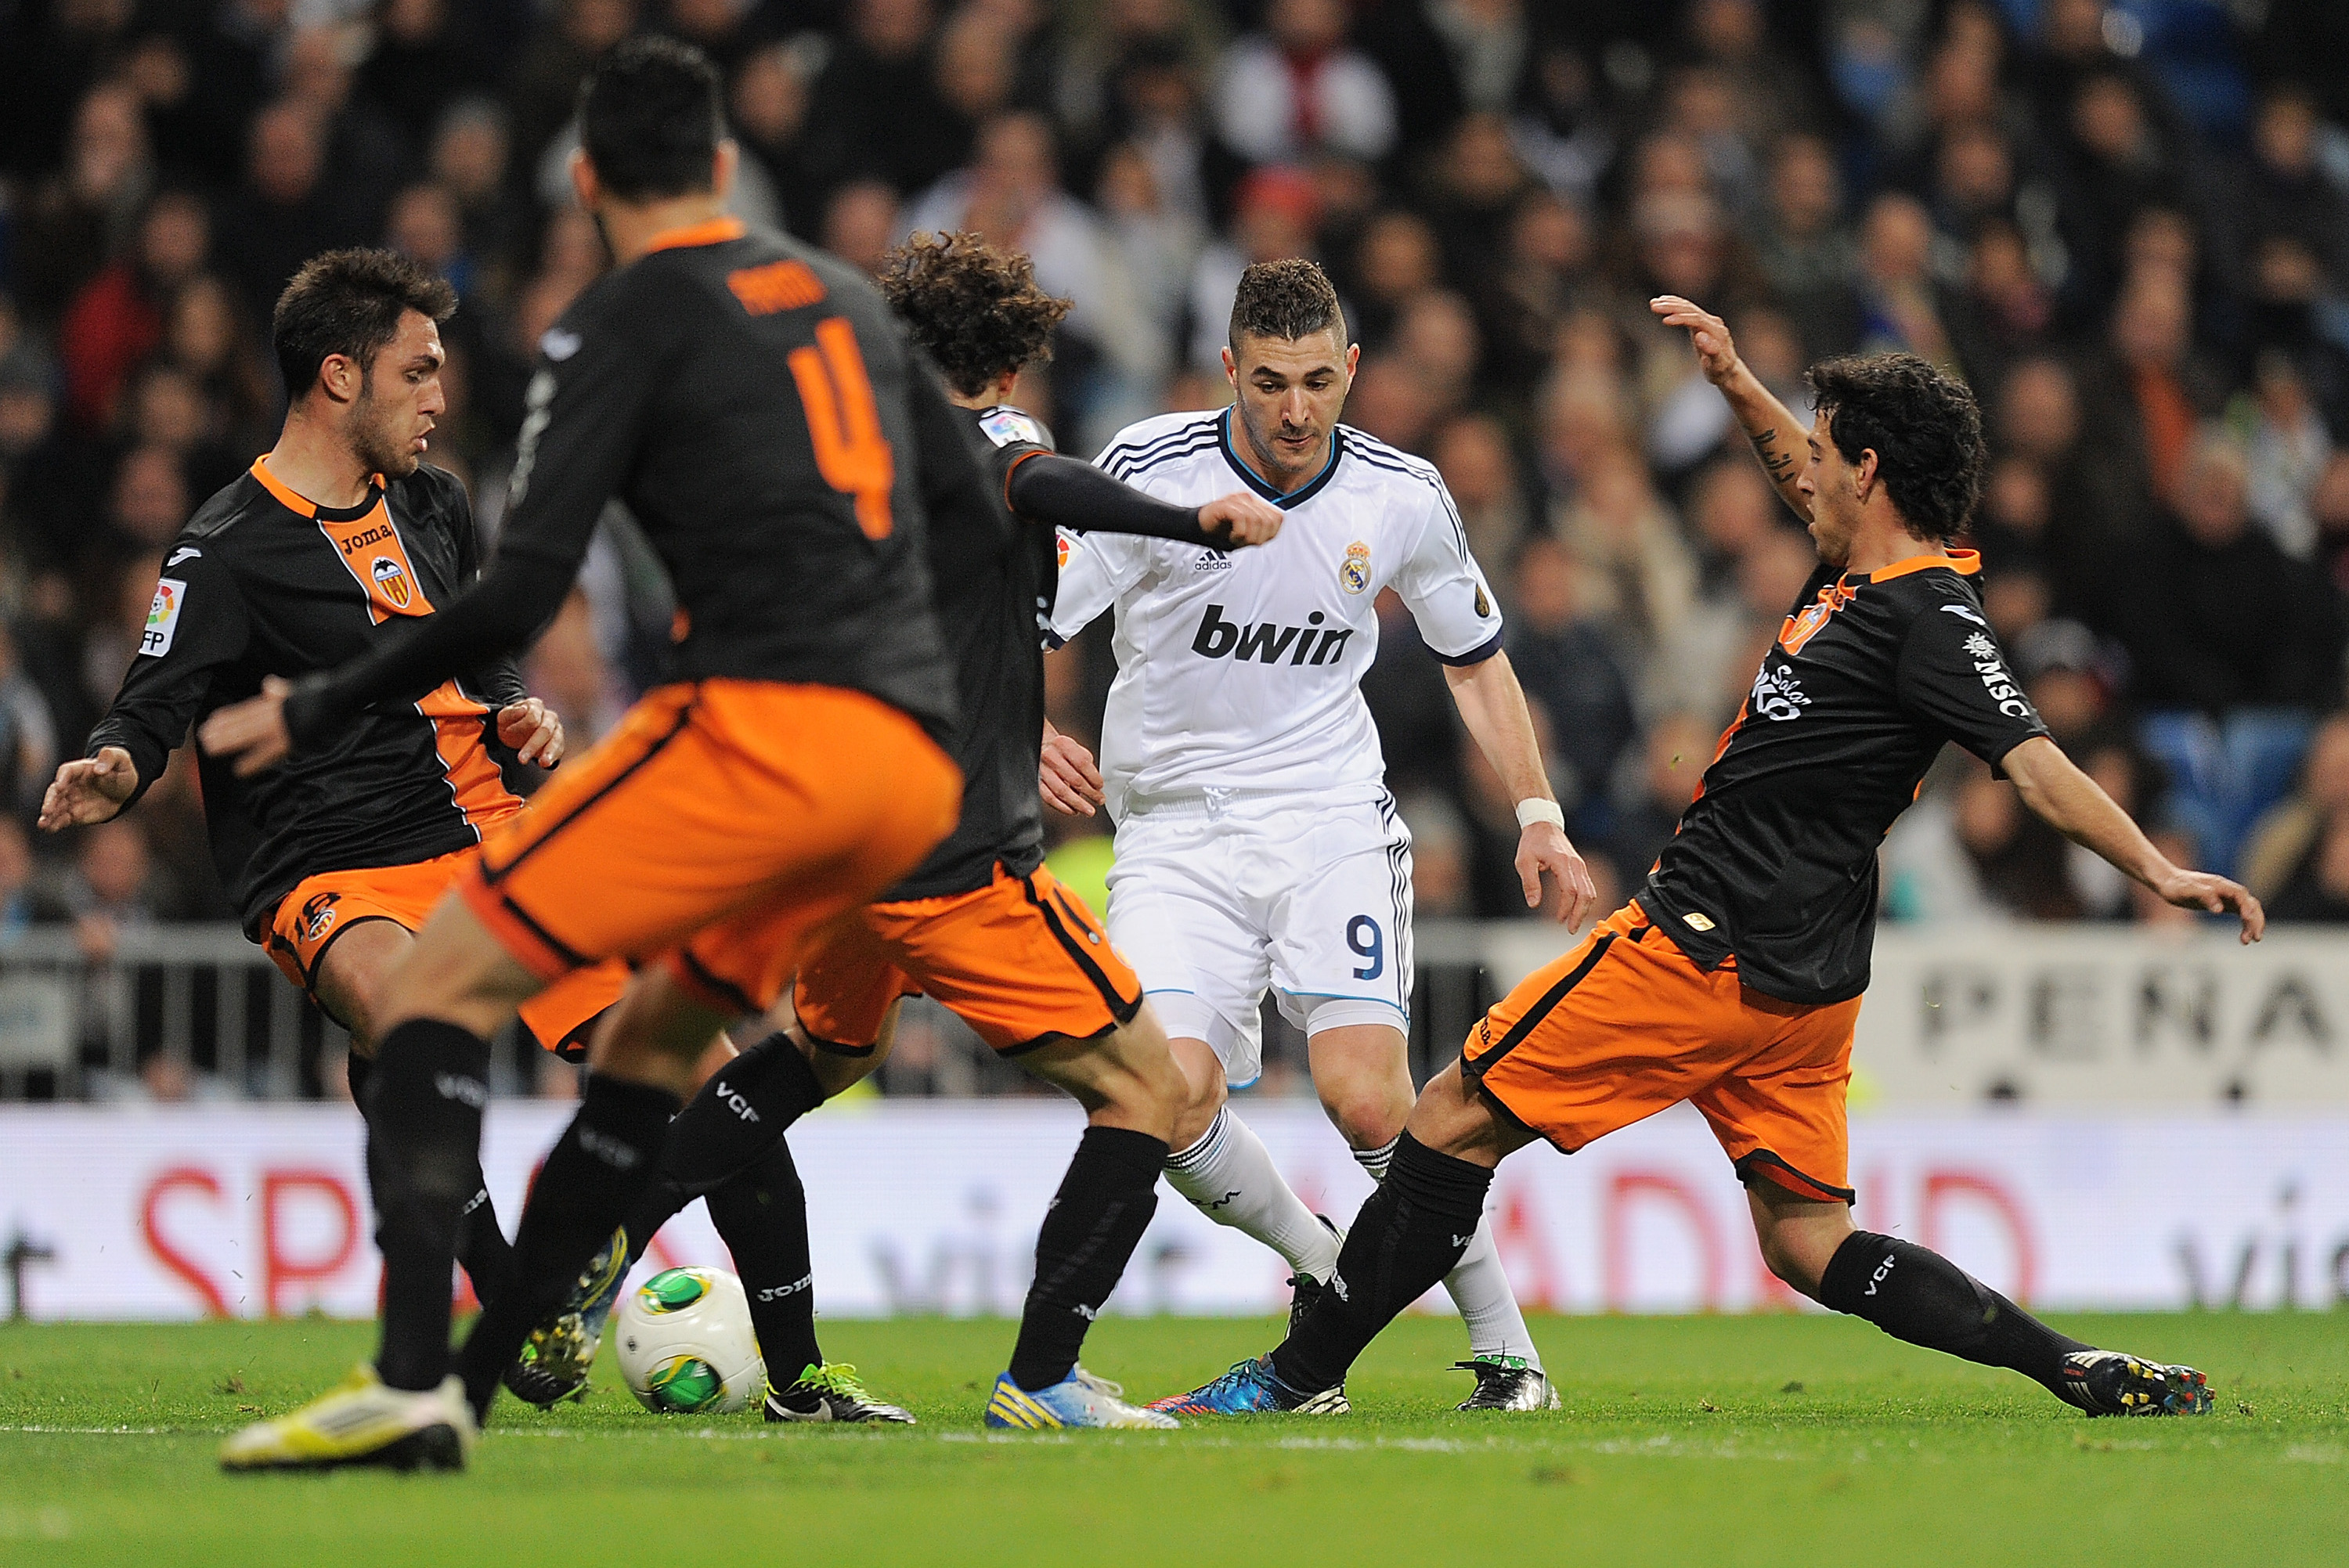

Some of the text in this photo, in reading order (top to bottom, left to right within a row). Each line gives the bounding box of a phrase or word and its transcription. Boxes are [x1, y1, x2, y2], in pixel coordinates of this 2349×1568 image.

[787, 316, 894, 540] 4
[1195, 559, 1232, 571] adidas
[1191, 604, 1354, 666] bwin
[1770, 665, 1812, 705] Solar
[1973, 660, 2030, 717] MSC
[1346, 914, 1383, 981] 9
[716, 1081, 760, 1123] VCF
[1864, 1254, 1896, 1296] VCF
